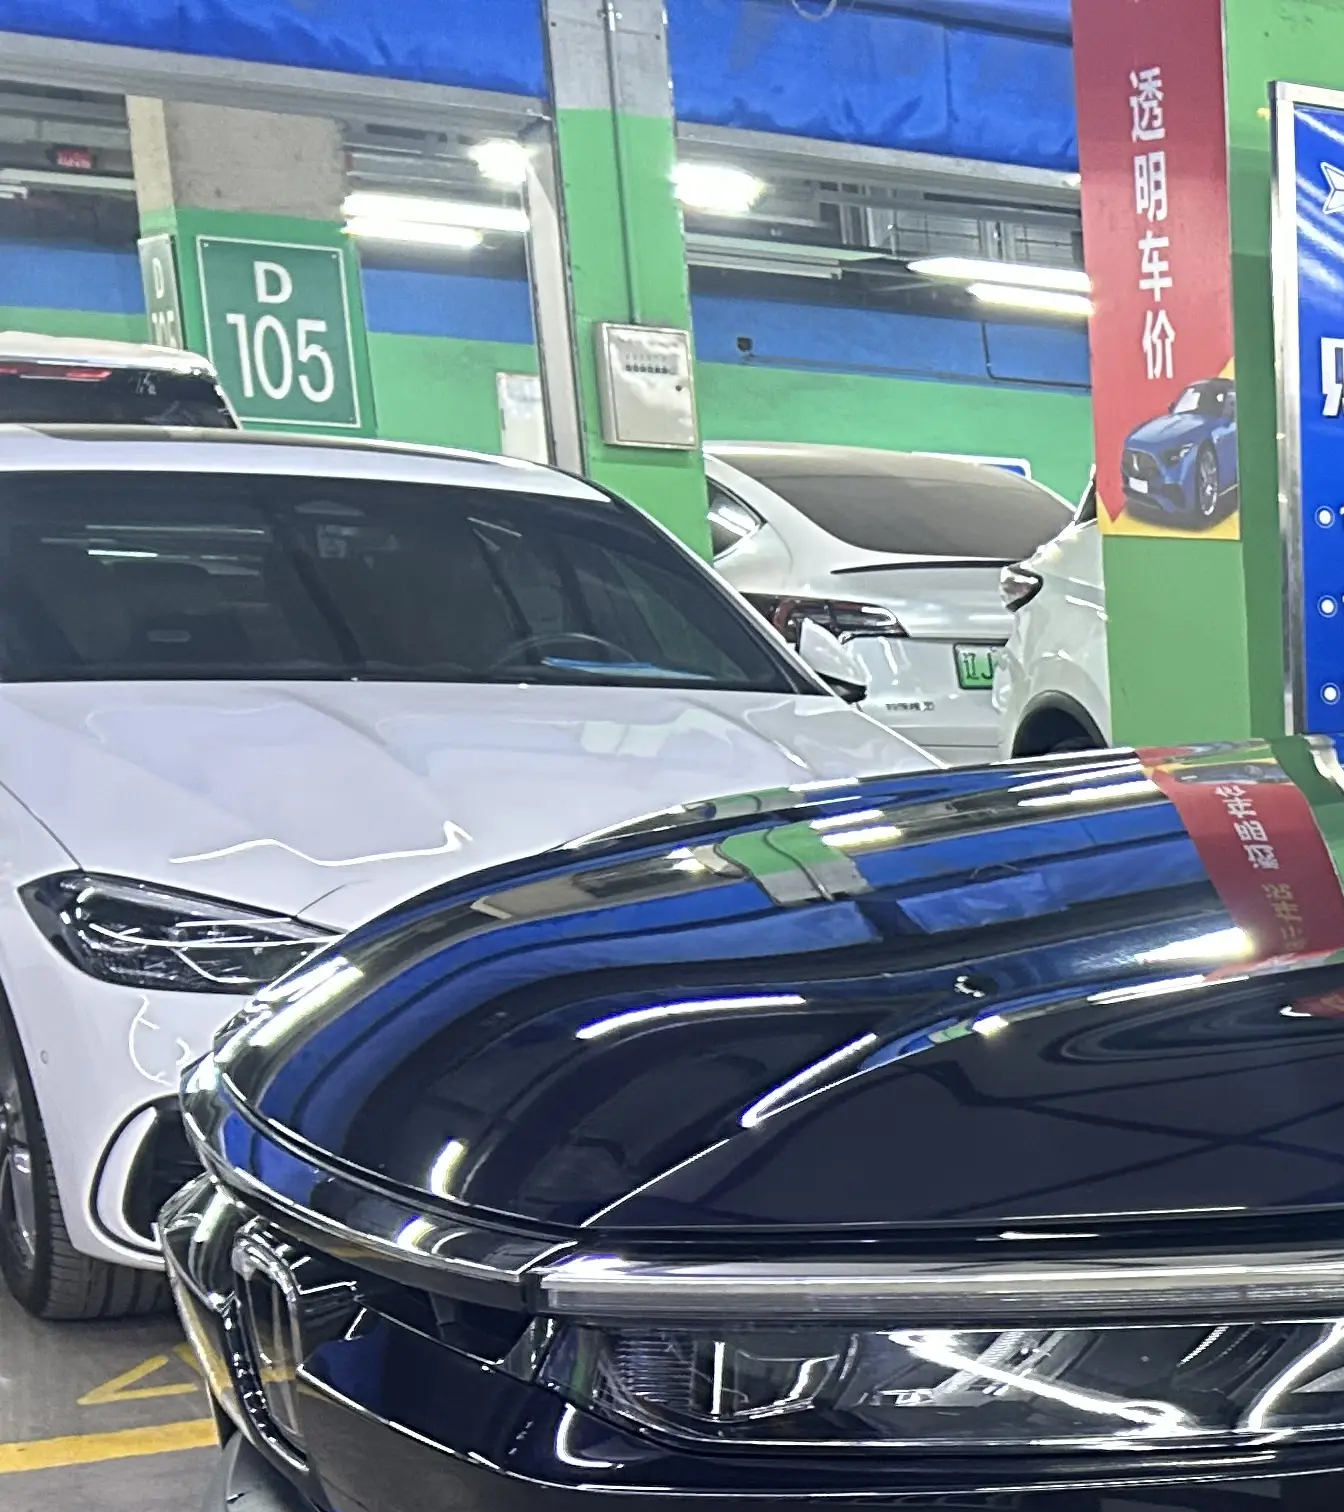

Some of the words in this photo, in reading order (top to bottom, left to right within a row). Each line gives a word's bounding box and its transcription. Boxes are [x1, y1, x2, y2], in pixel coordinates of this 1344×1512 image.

[1129, 66, 1175, 380] 透明车价
[152, 257, 165, 299] D
[253, 260, 293, 304] D
[226, 313, 334, 403] 105
